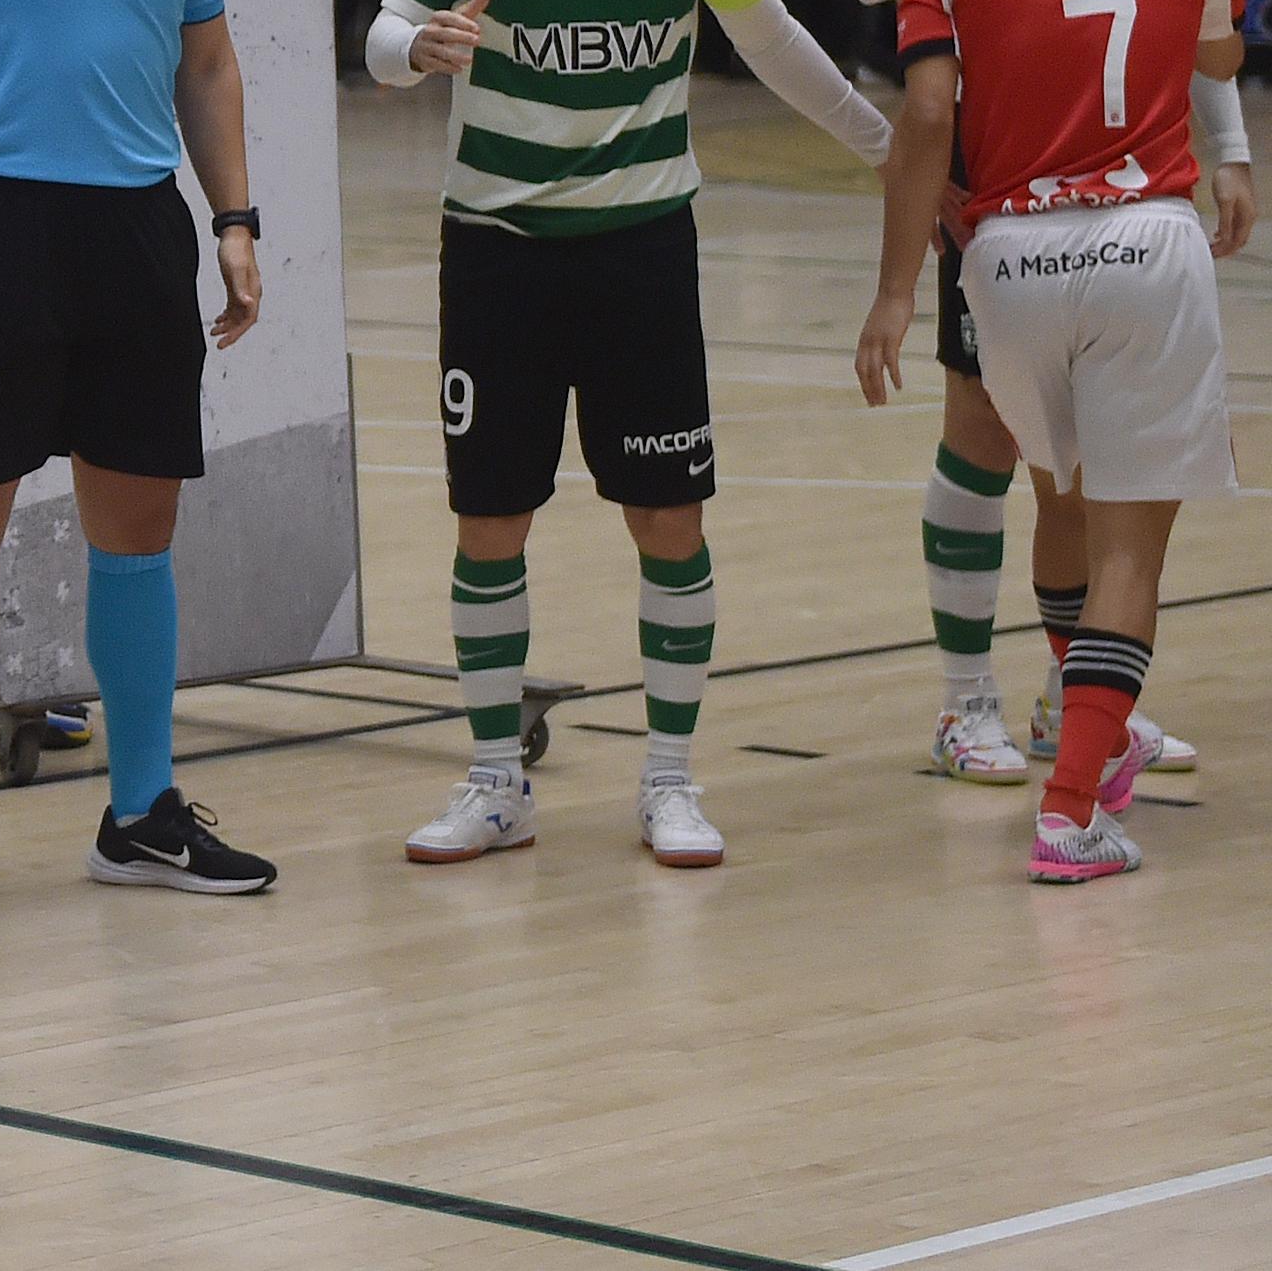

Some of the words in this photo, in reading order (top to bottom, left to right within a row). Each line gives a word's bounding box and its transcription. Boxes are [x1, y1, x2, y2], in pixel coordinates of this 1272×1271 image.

[511, 17, 676, 75] MBW
[995, 258, 1011, 281] A
[1020, 241, 1150, 279] MatosCar
